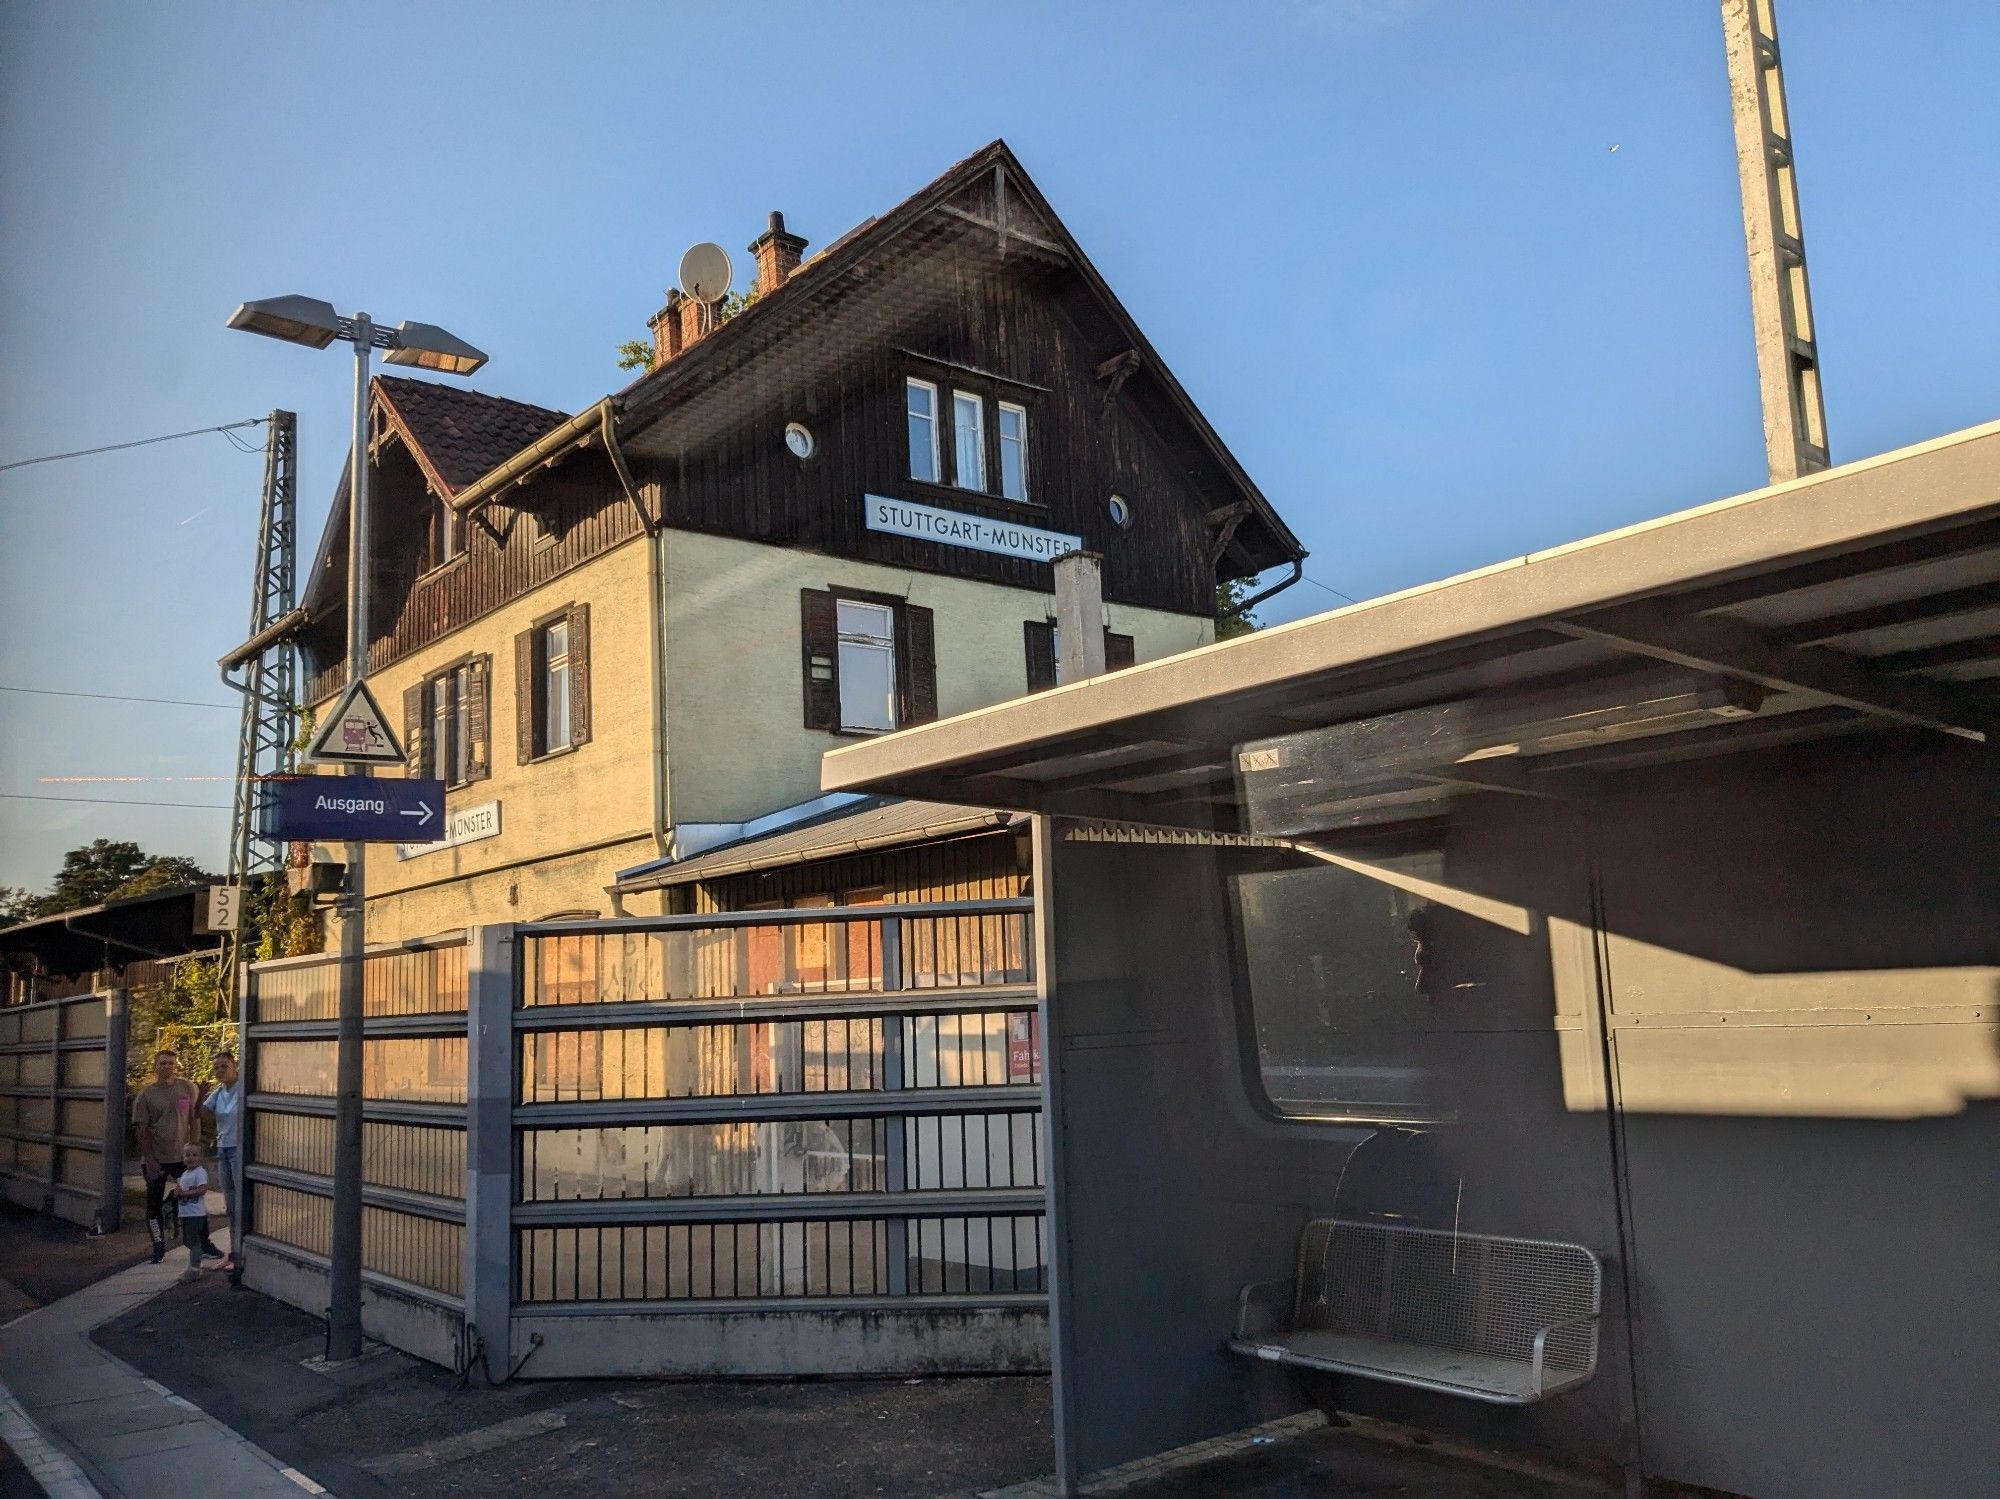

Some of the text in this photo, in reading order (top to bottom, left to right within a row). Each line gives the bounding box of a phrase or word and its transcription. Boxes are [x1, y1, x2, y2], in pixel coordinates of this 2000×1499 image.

[878, 504, 1072, 556] STUTTGART-MÜNSTER
[314, 794, 384, 814] Ausgang
[216, 887, 230, 906] 5
[216, 908, 230, 926] 2
